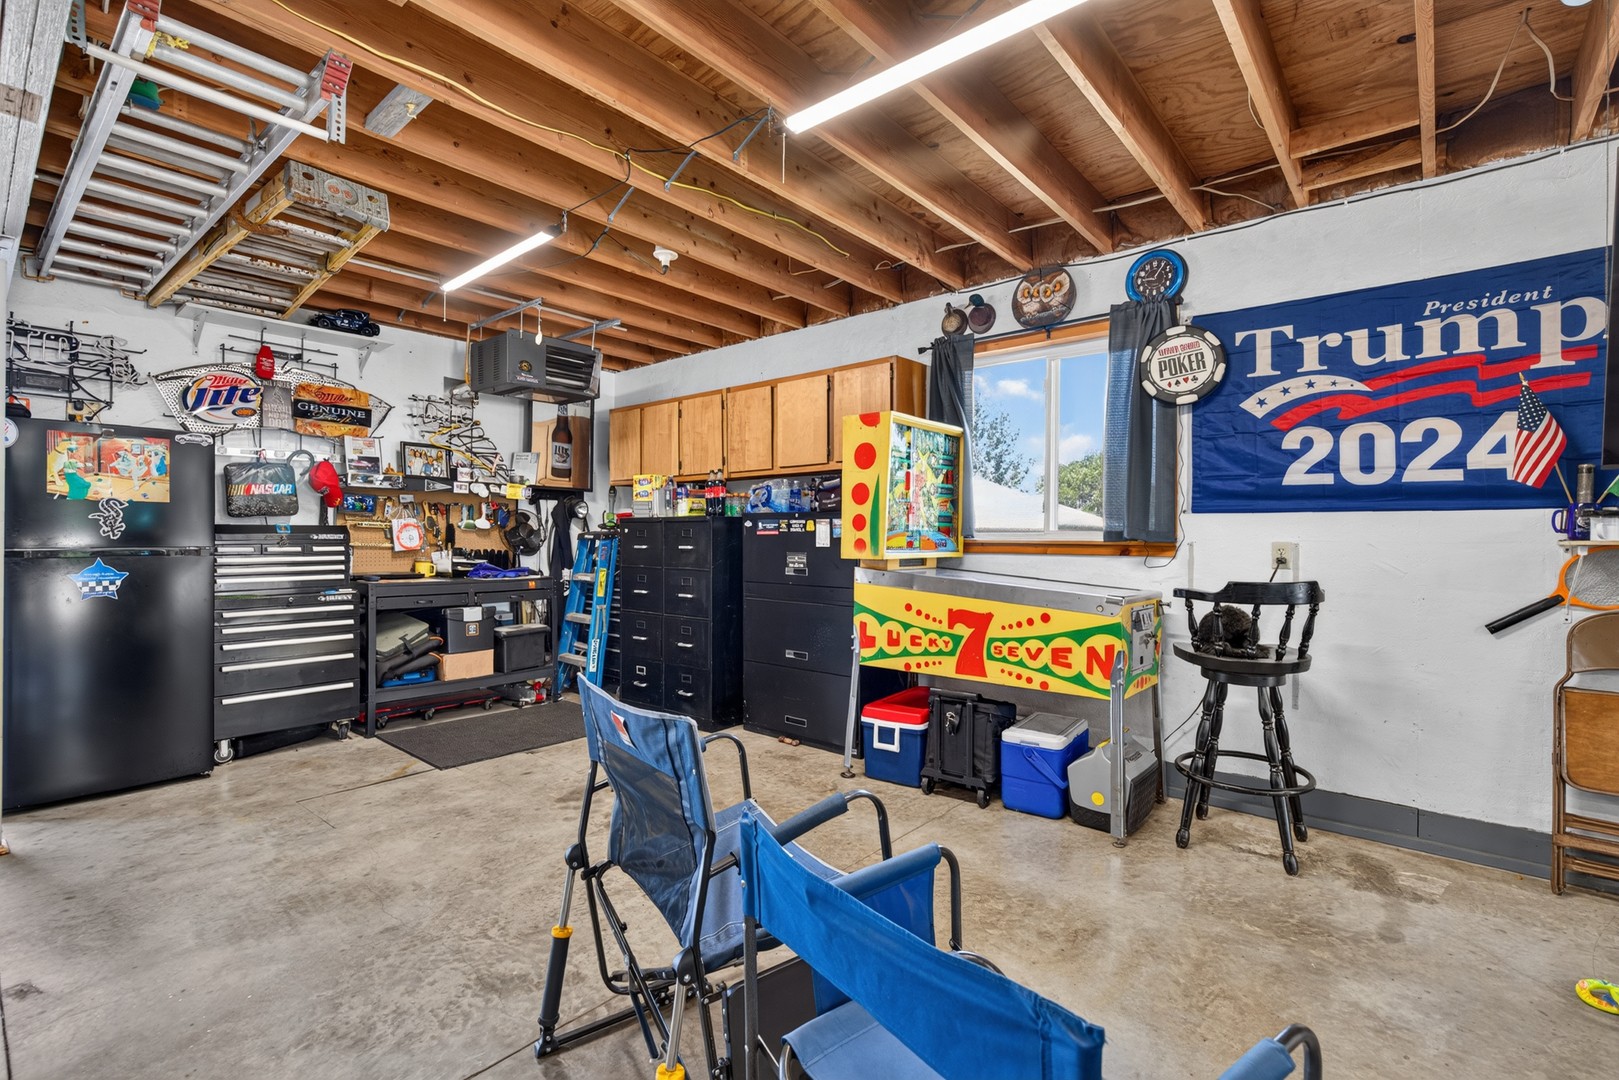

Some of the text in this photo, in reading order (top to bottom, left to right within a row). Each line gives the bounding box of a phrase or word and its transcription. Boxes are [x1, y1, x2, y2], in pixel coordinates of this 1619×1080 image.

[1423, 285, 1553, 317] President
[1234, 296, 1609, 378] Trump
[1157, 351, 1207, 379] POKER
[188, 385, 263, 412] Lite
[297, 401, 366, 419] GENUINE
[1281, 411, 1519, 486] 2024
[250, 483, 293, 496] NASCAR
[859, 607, 1116, 681] LUCKY 7 SEVEN
